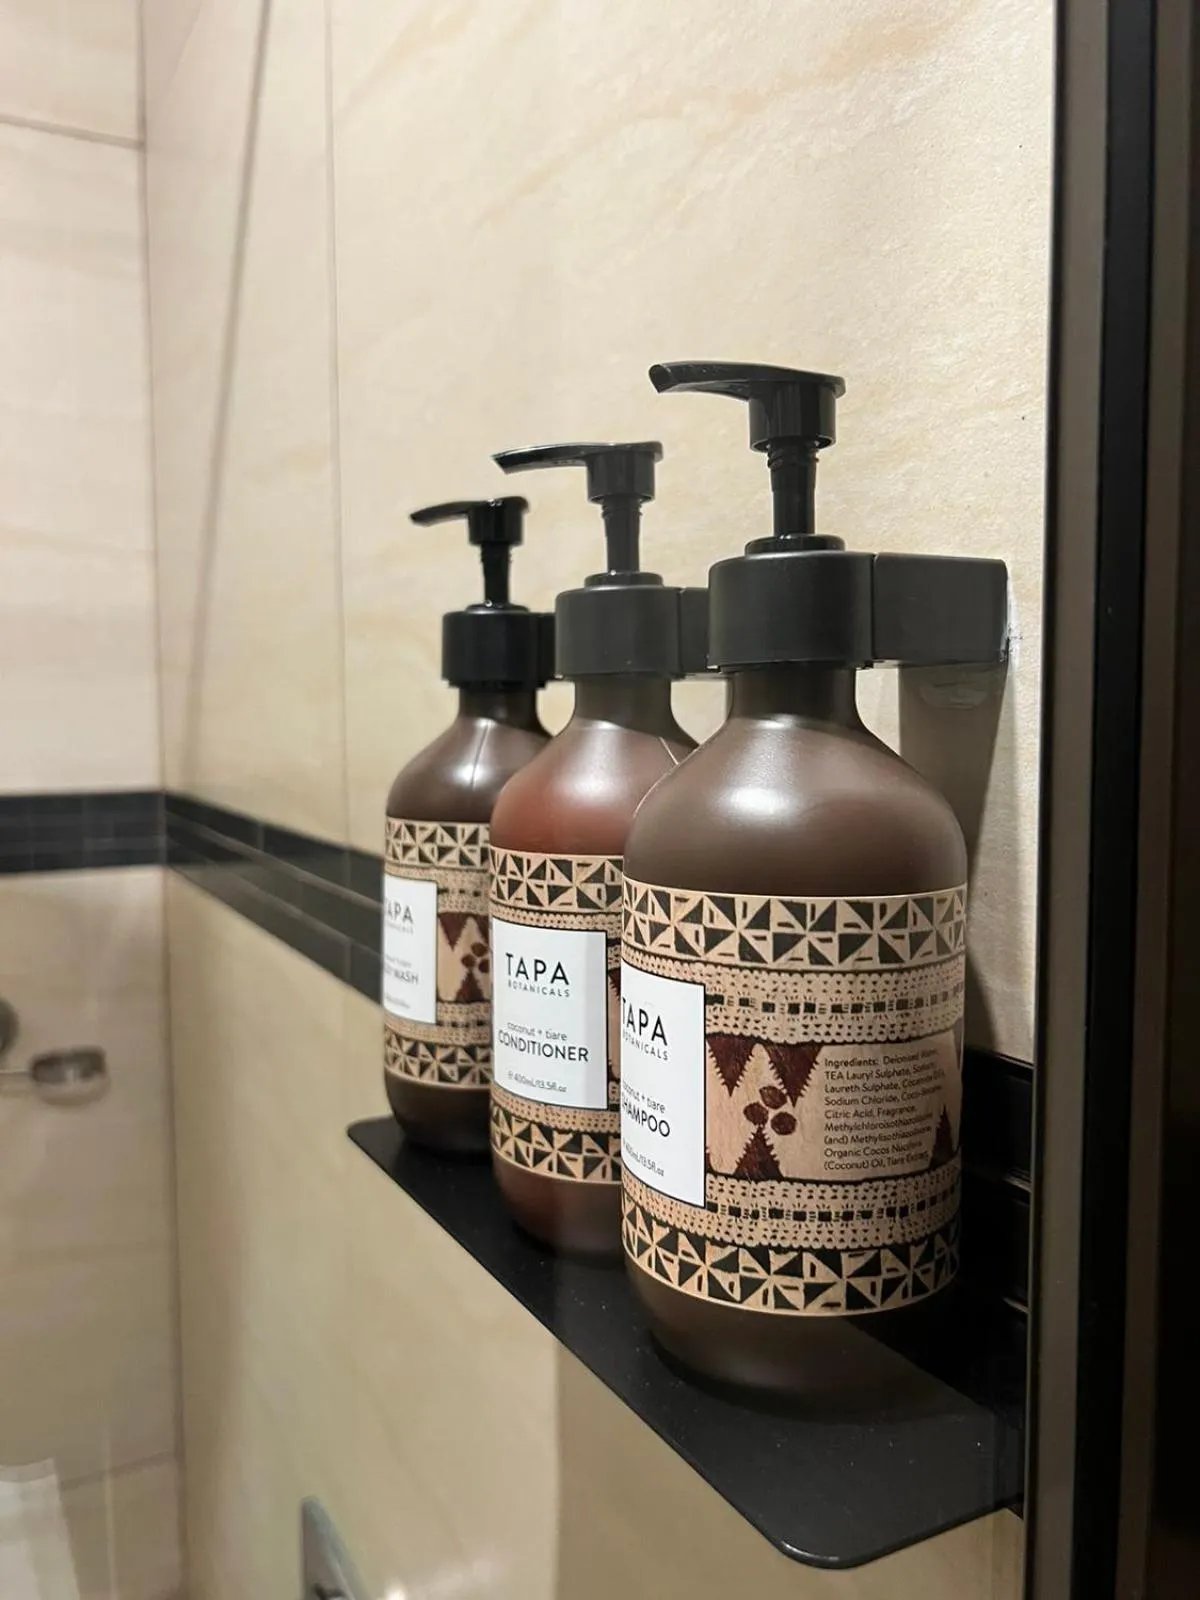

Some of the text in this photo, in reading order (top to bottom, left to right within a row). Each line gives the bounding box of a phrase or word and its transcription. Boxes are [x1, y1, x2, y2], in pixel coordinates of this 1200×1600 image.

[386, 897, 414, 925] APA
[505, 952, 570, 985] TAPA
[508, 979, 570, 998] BOTANICALS
[507, 1022, 536, 1037] coconut
[622, 996, 668, 1046] TAPA
[498, 1029, 589, 1062] CONDITIONER
[622, 1028, 668, 1061] OTANICALS
[824, 1057, 879, 1069] Ingredients:
[824, 1071, 844, 1080] TEA
[846, 1070, 873, 1081] Lauryl
[824, 1083, 860, 1093] Laureth
[862, 1081, 901, 1092] Sulphate,
[824, 1095, 860, 1106] Sodium
[824, 1109, 852, 1119] Citric
[824, 1112, 933, 1133] Methylchloroisothiaz
[824, 1126, 932, 1145] (and) Methylisothiaz
[824, 1147, 861, 1159] Organic
[863, 1146, 890, 1156] Cocos
[824, 1160, 870, 1170] (Coconut)
